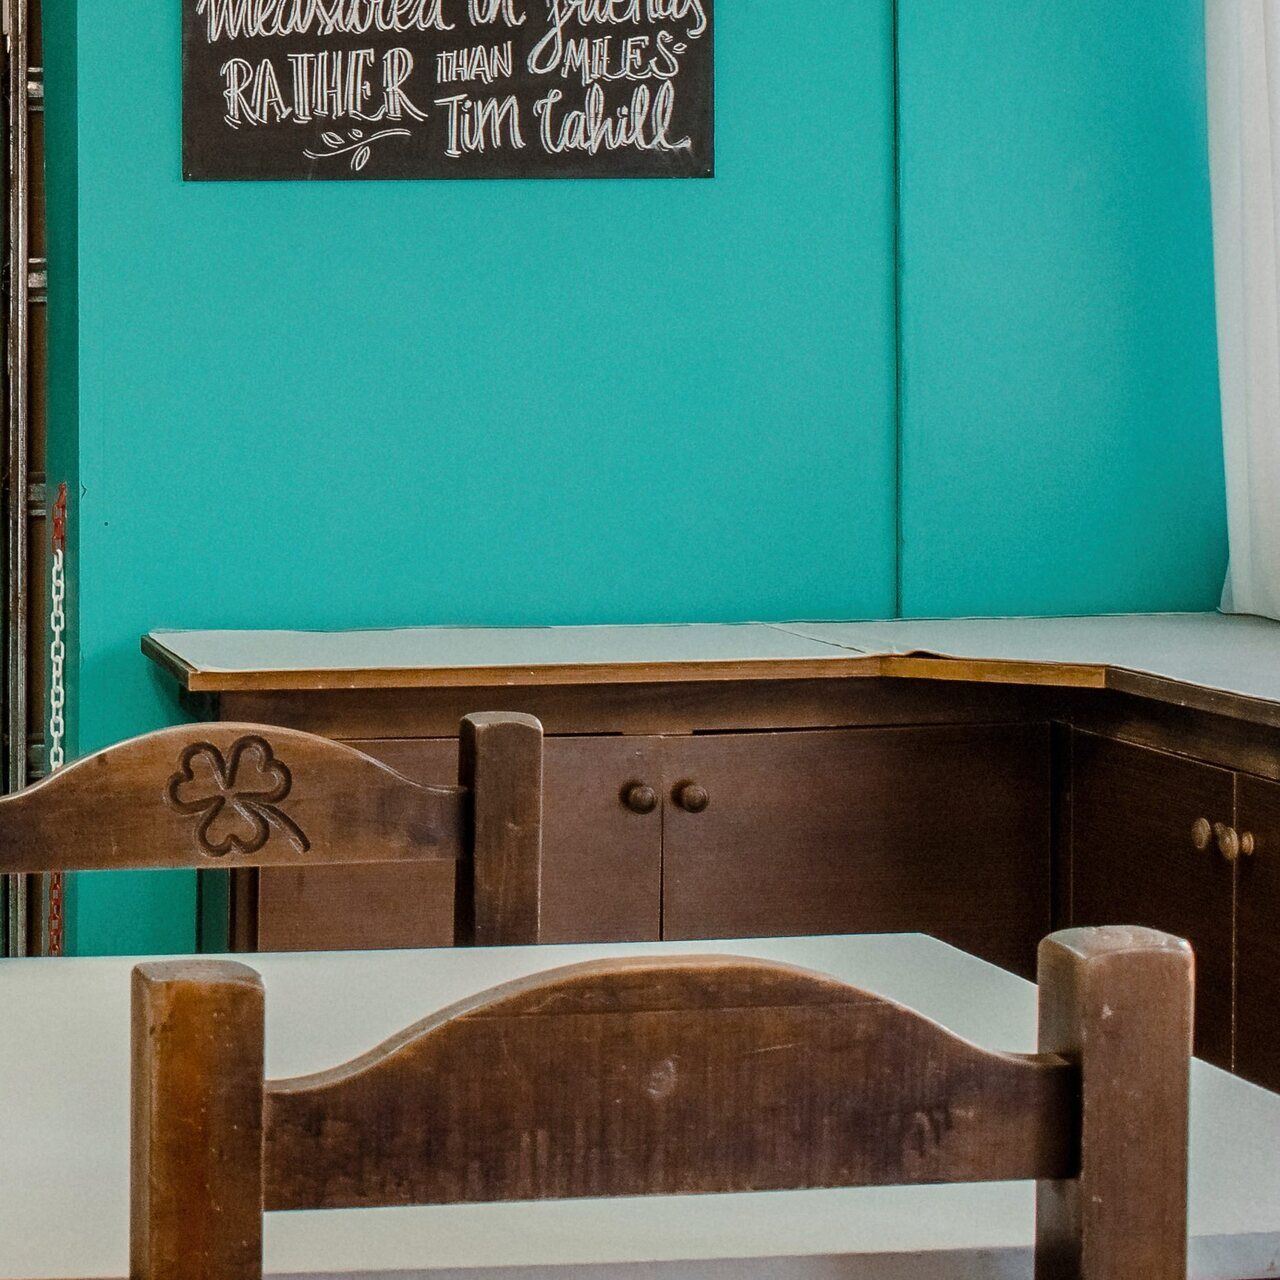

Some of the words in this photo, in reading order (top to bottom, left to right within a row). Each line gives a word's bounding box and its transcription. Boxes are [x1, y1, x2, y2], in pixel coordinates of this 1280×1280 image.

[219, 47, 428, 130] RATHER
[436, 41, 513, 84] THAN
[560, 30, 680, 87] MILES
[533, 79, 693, 156] Cahill
